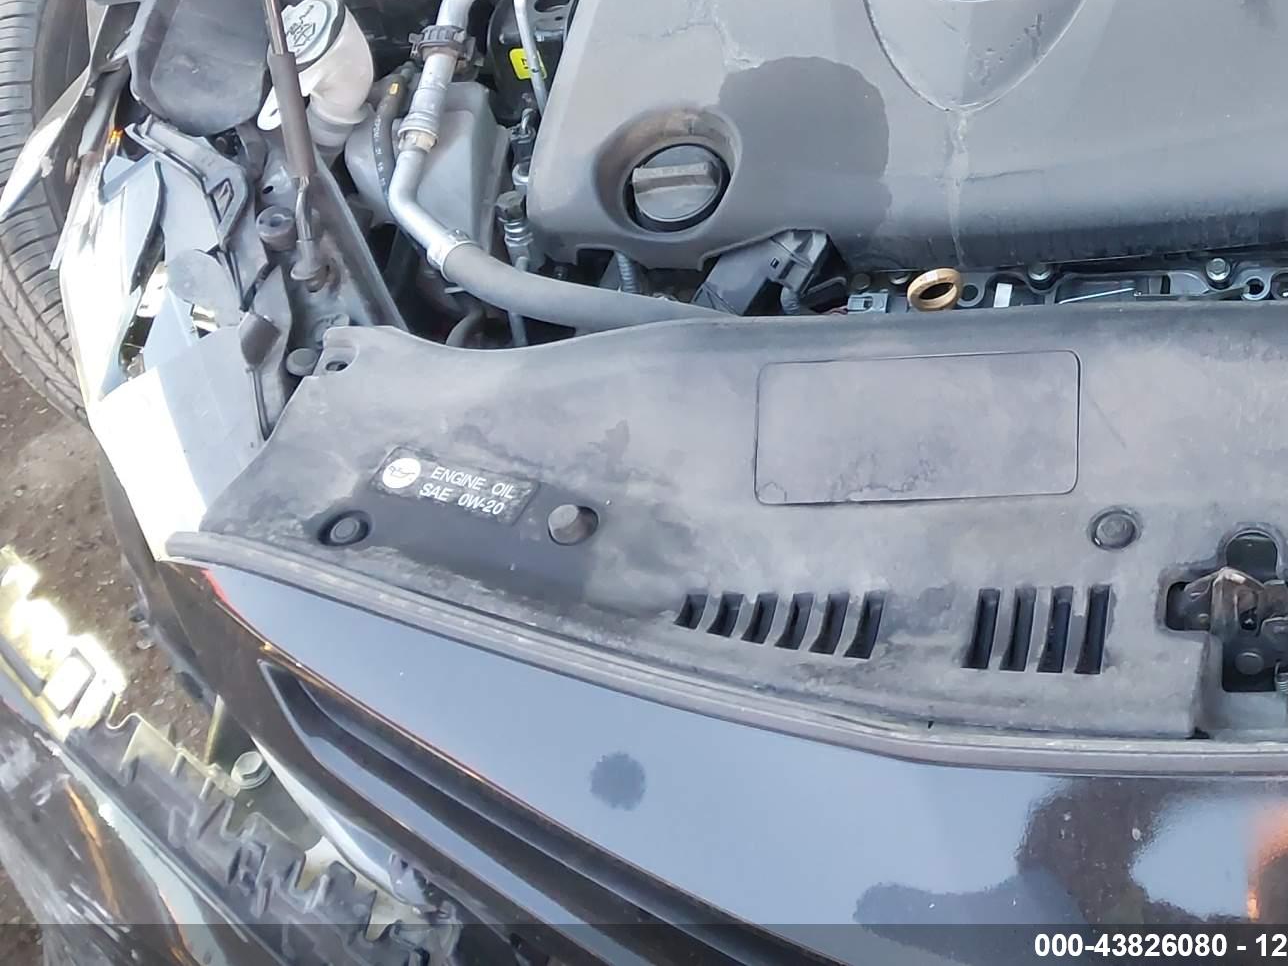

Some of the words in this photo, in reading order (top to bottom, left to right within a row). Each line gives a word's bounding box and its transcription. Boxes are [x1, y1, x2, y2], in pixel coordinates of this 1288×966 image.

[430, 466, 487, 491] ENGINE
[491, 482, 518, 499] OIL
[419, 483, 453, 502] SAE
[458, 493, 505, 515] 0W-20
